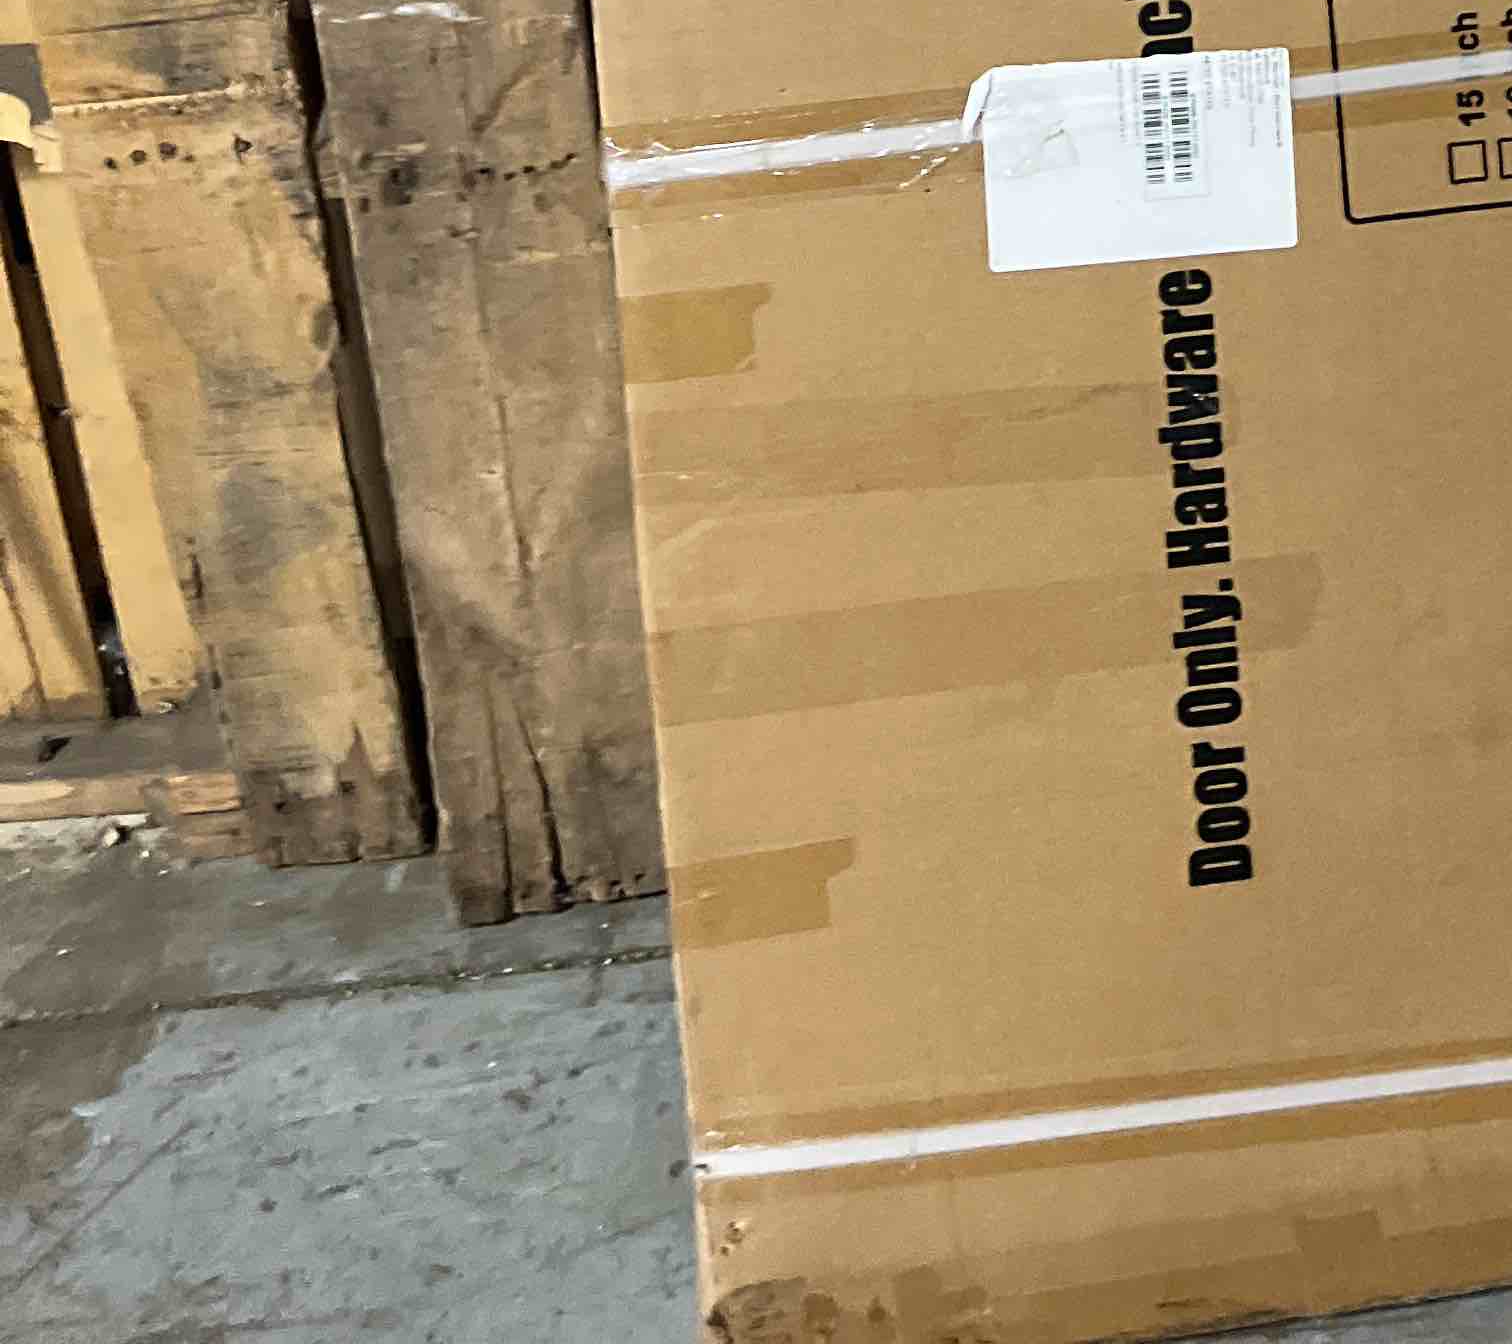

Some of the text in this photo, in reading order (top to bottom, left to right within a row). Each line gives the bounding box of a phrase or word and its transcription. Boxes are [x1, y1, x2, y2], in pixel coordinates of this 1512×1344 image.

[1456, 90, 1486, 126] 15
[1158, 269, 1230, 568] Hardware
[1173, 579, 1242, 727] Only.
[1189, 742, 1253, 887] Door
